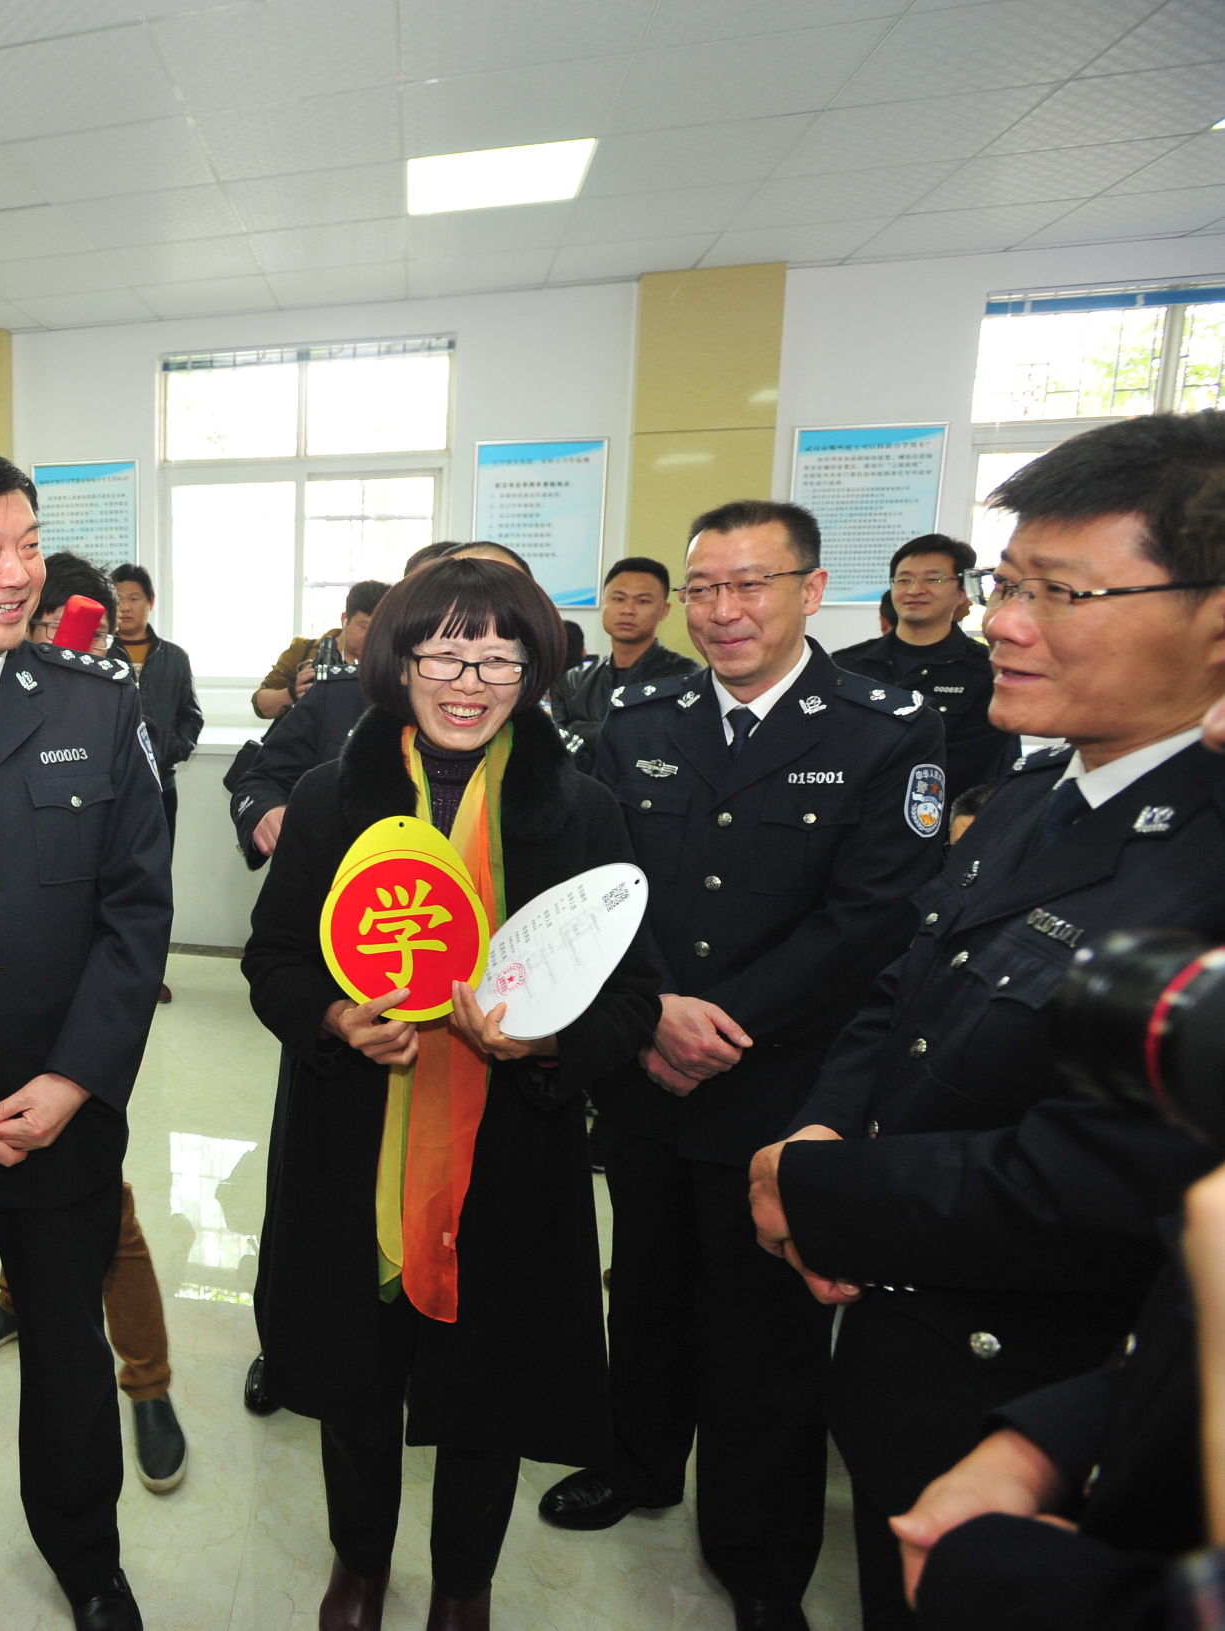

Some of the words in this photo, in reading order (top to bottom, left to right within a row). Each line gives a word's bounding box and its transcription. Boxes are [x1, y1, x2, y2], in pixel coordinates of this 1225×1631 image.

[39, 747, 89, 765] 000003
[787, 771, 845, 785] 015001
[356, 879, 453, 990] 学
